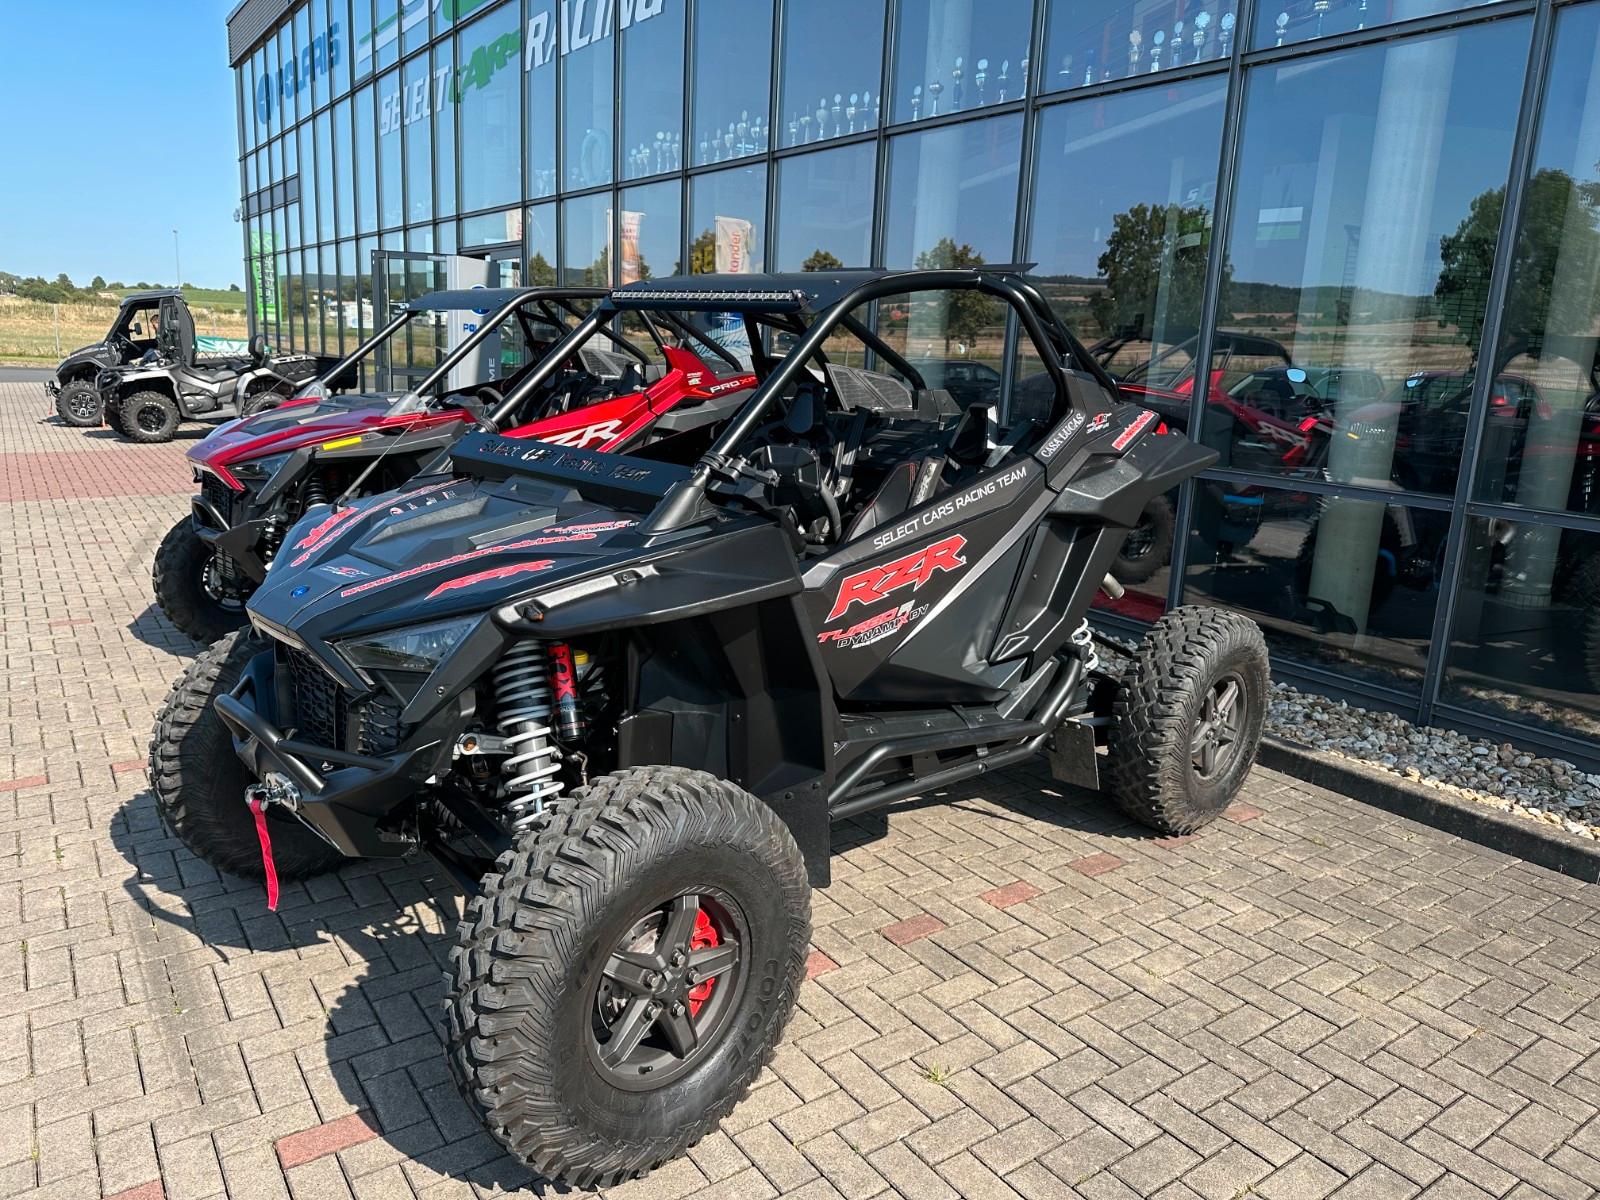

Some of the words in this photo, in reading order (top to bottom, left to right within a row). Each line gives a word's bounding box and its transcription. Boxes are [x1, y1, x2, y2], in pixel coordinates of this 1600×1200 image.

[380, 65, 451, 136] SELECT
[710, 380, 741, 394] PRO
[1041, 435, 1063, 458] CASA
[1058, 412, 1086, 438] LUCAS
[873, 518, 920, 551] SELECT
[922, 502, 954, 526] CARS
[955, 482, 996, 511] RACING
[996, 466, 1027, 490] TEAM
[824, 533, 968, 624] RZR
[817, 607, 900, 643] TURBO
